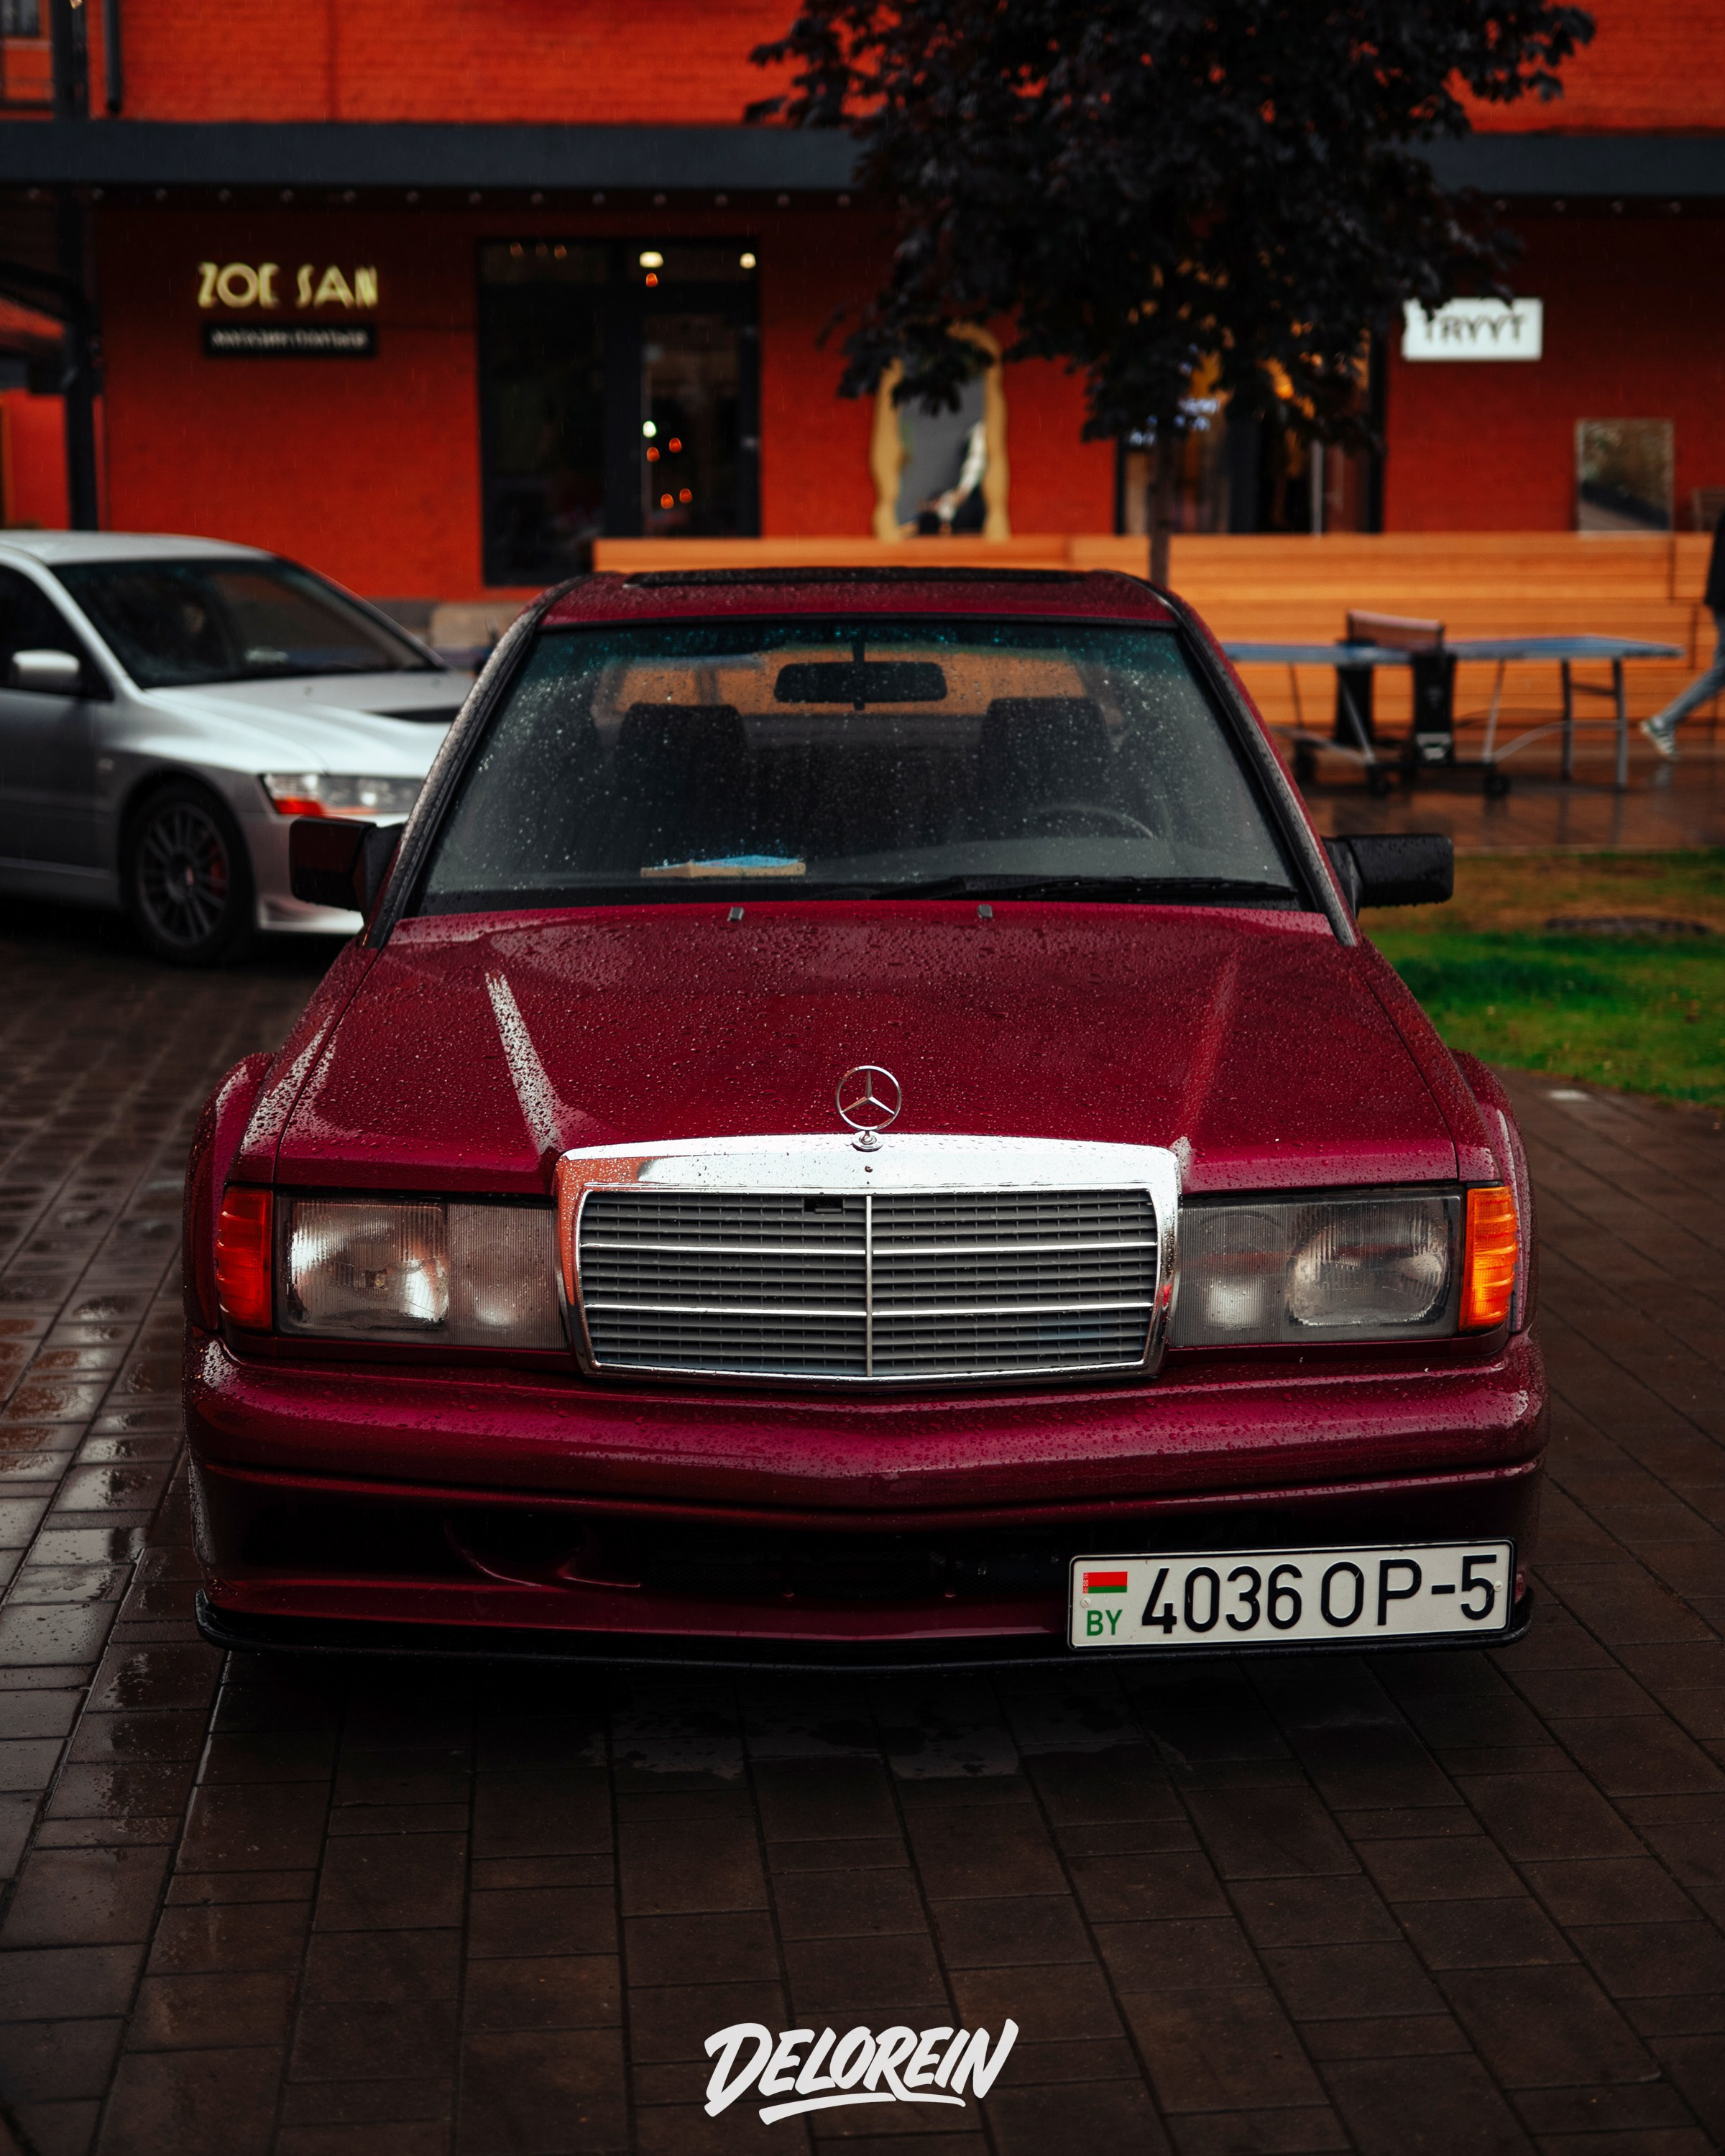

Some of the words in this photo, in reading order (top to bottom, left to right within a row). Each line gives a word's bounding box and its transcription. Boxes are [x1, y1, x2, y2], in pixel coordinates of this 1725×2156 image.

[295, 263, 378, 309] SAN
[1141, 1563, 1303, 1635] 4036
[1085, 1609, 1123, 1636] BY
